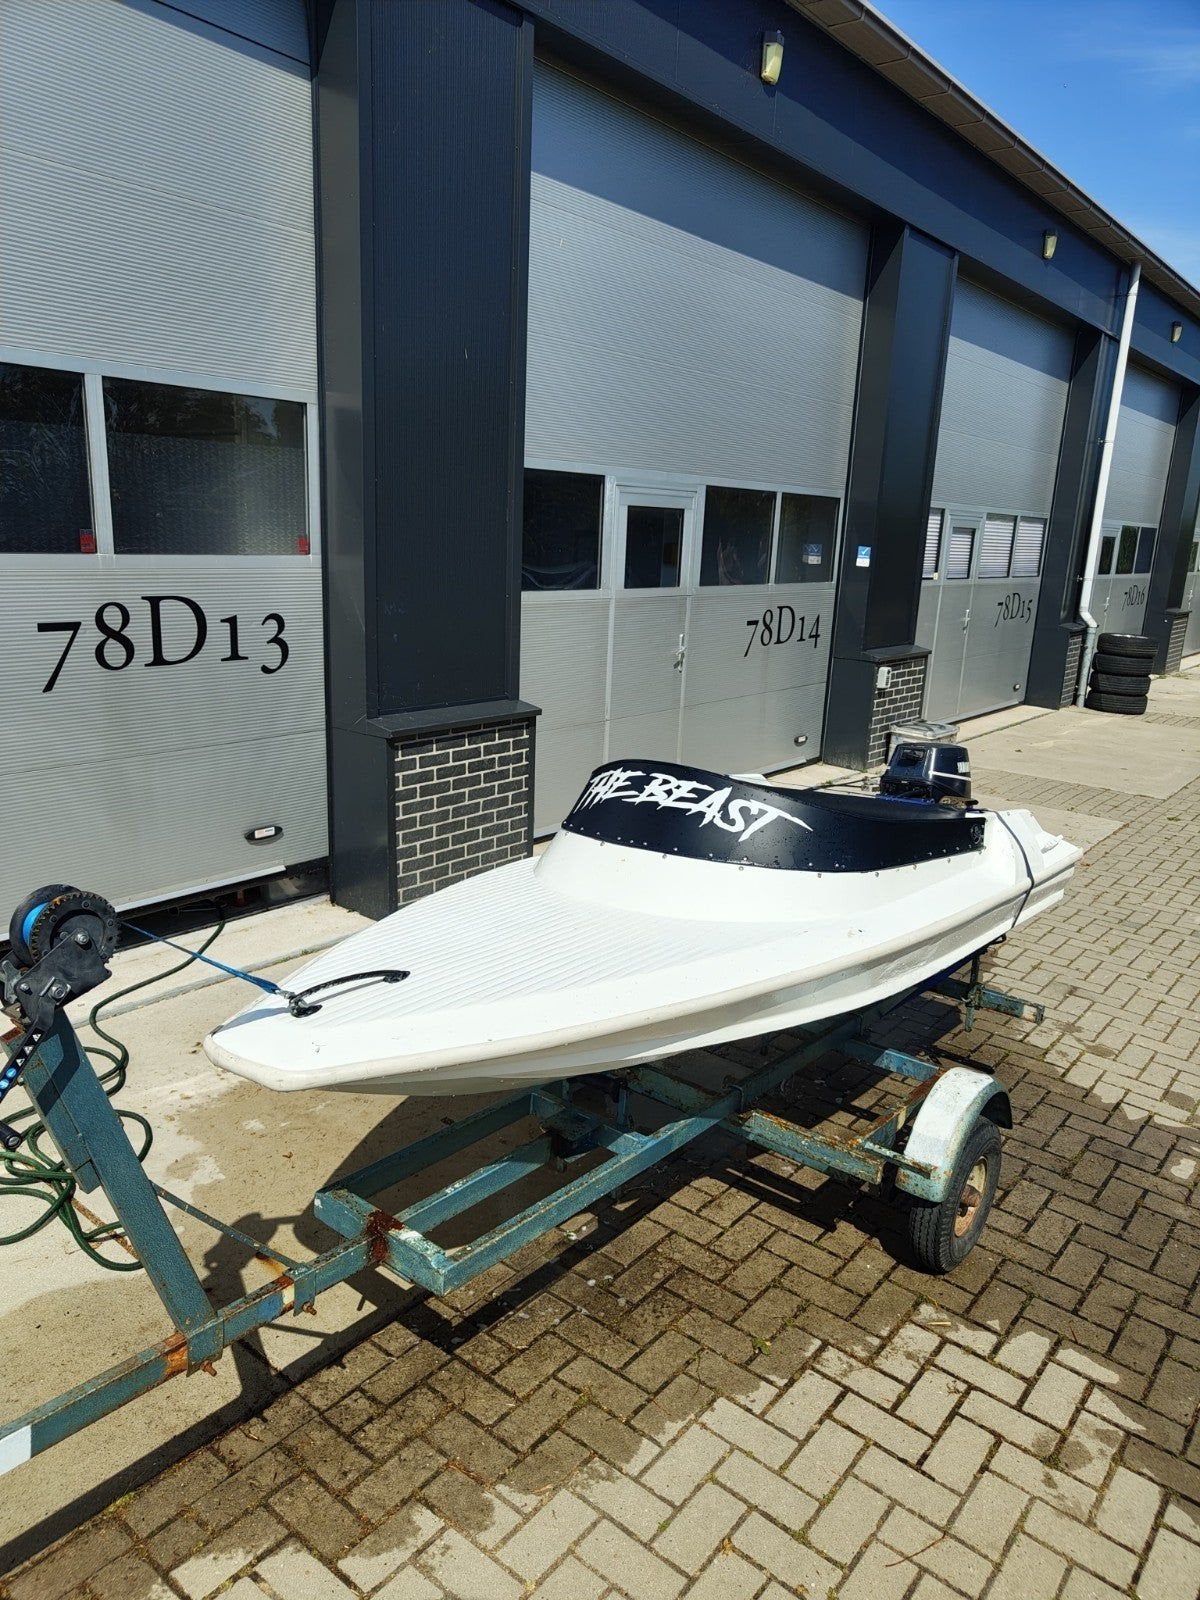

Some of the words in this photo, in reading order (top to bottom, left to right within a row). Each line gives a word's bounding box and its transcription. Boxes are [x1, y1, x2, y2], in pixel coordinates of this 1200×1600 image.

[994, 592, 1033, 628] 78D15
[1121, 584, 1146, 611] 78D16
[37, 595, 290, 693] 78D13
[743, 605, 821, 657] 78D14
[573, 766, 647, 814] THE
[621, 772, 814, 842] BEAST
